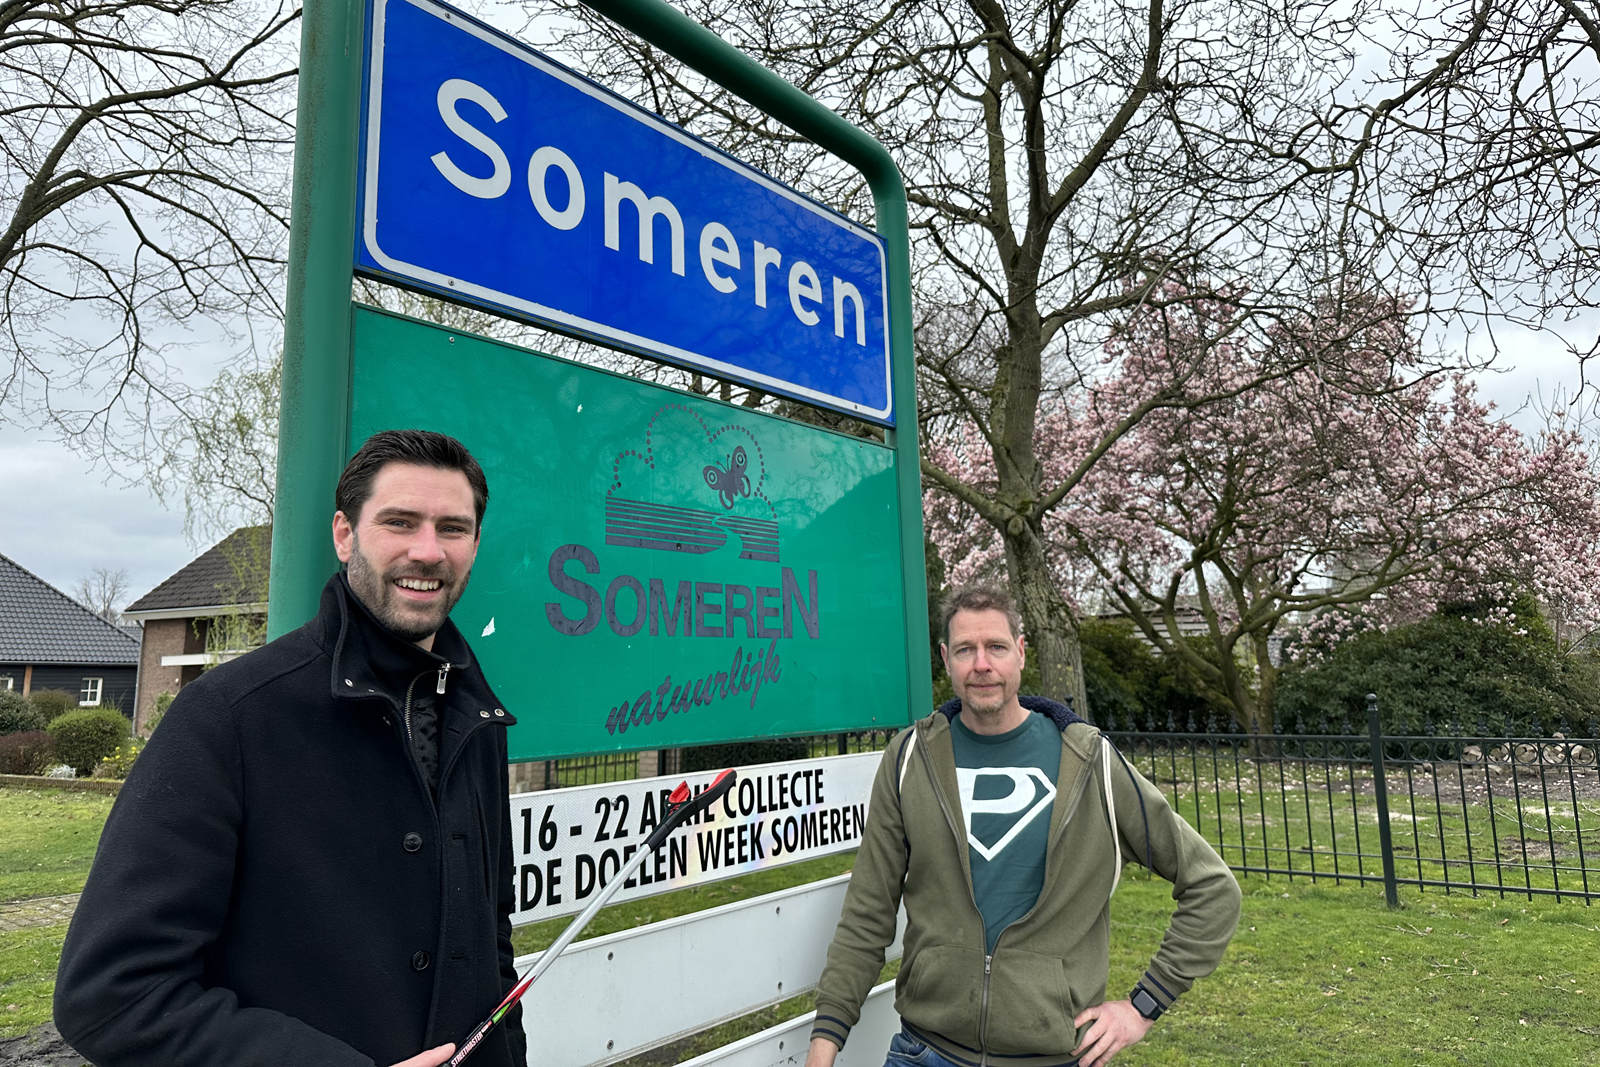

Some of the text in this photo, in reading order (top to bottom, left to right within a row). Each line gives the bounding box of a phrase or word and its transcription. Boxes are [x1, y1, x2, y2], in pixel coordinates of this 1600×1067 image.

[430, 78, 866, 347] Someren
[545, 544, 820, 640] SOMEREN
[605, 637, 782, 736] natuurlijk
[513, 858, 562, 914] DE
[697, 821, 765, 872] WEEK
[771, 803, 865, 857] SOMEREN
[521, 804, 558, 855] 16
[594, 794, 630, 843] 22
[723, 769, 825, 819] COLLECTE
